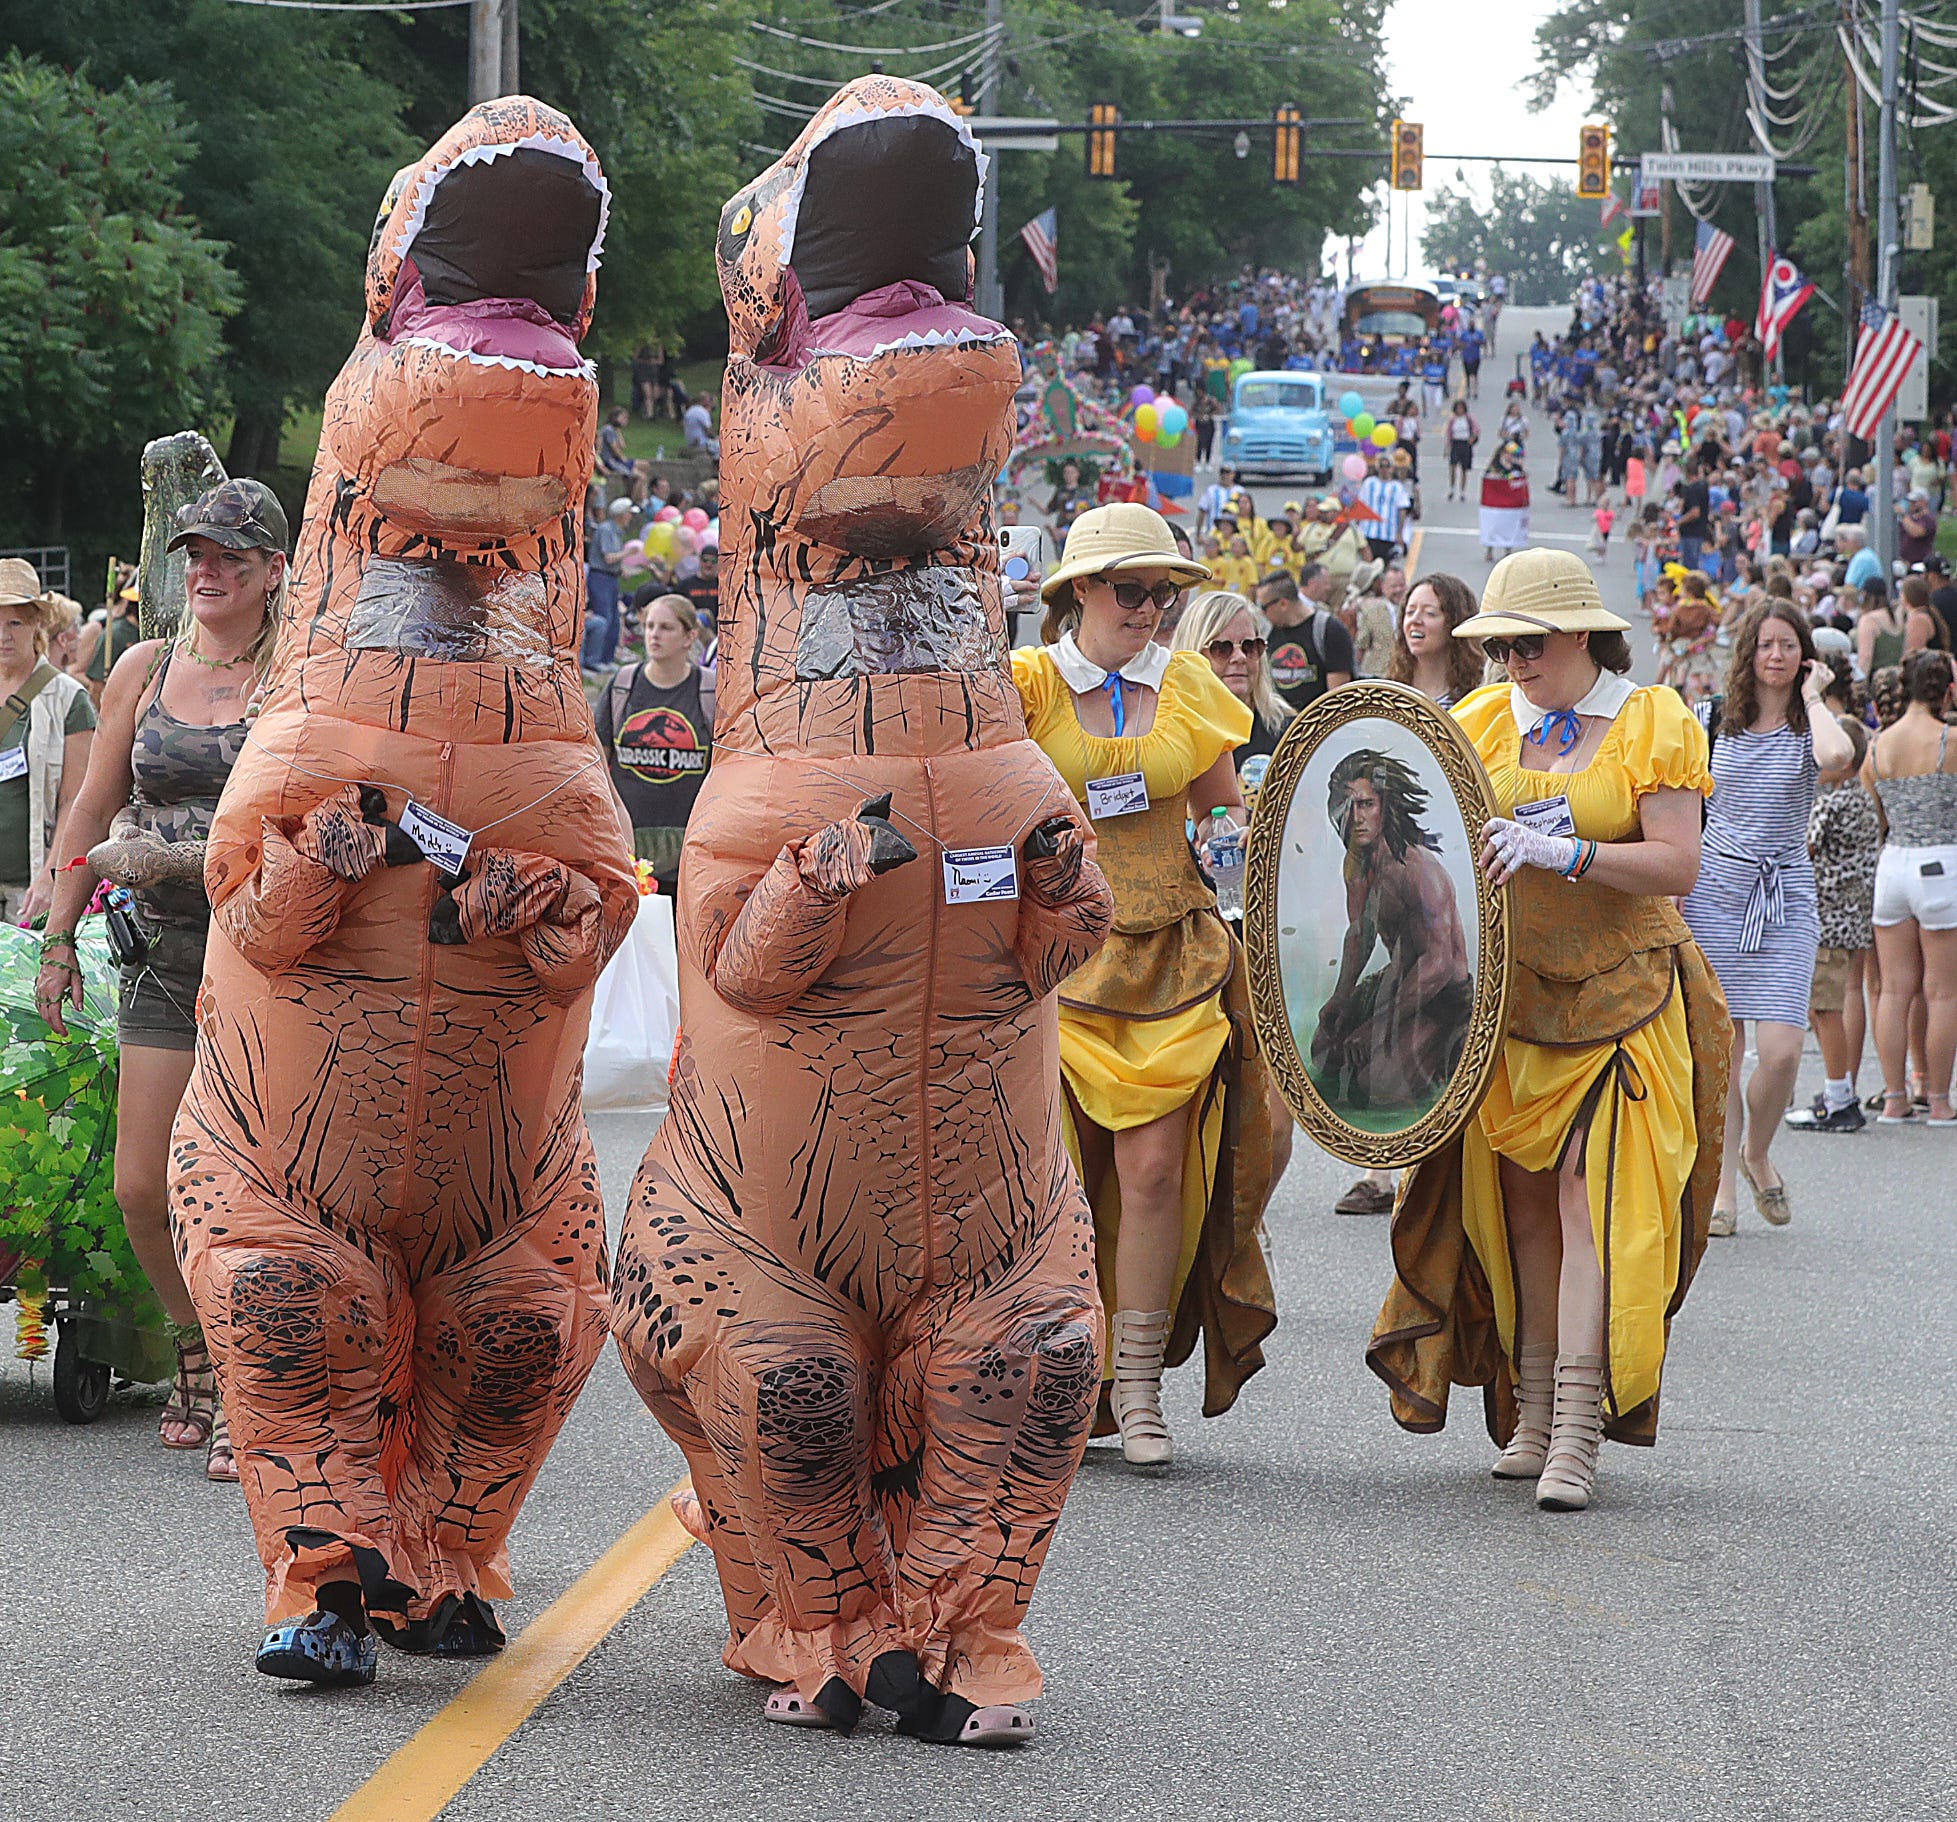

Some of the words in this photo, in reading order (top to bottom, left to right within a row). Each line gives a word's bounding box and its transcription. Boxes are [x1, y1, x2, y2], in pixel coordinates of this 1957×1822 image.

[1647, 158, 1682, 172] Twin
[1687, 158, 1721, 173] Hills
[1727, 159, 1770, 178] Pkwy
[669, 748, 704, 769] PARK
[1100, 788, 1135, 805] Bridget
